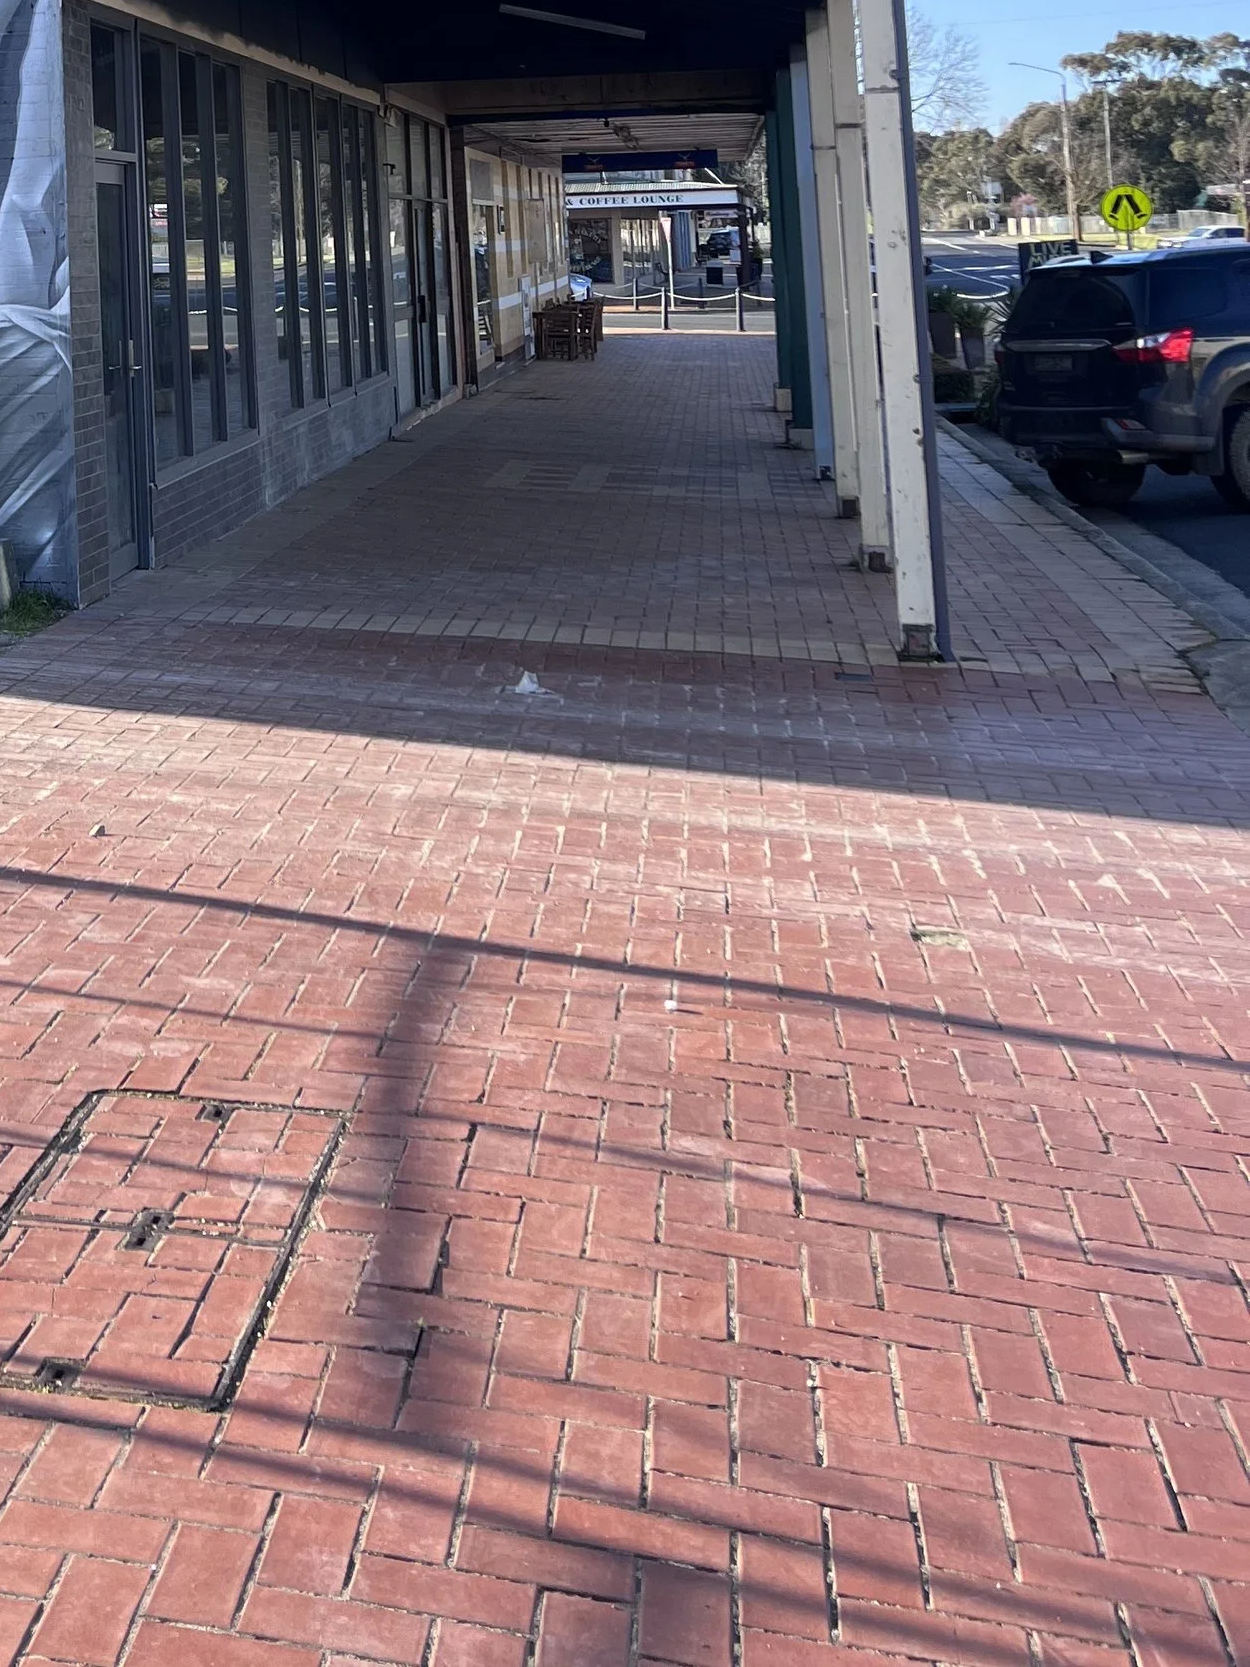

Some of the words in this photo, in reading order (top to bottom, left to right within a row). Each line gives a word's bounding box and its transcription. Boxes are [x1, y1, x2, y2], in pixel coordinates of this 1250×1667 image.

[579, 196, 629, 206] COFFEE
[633, 194, 684, 204] LOUNGE
[1029, 241, 1072, 256] LIVE
